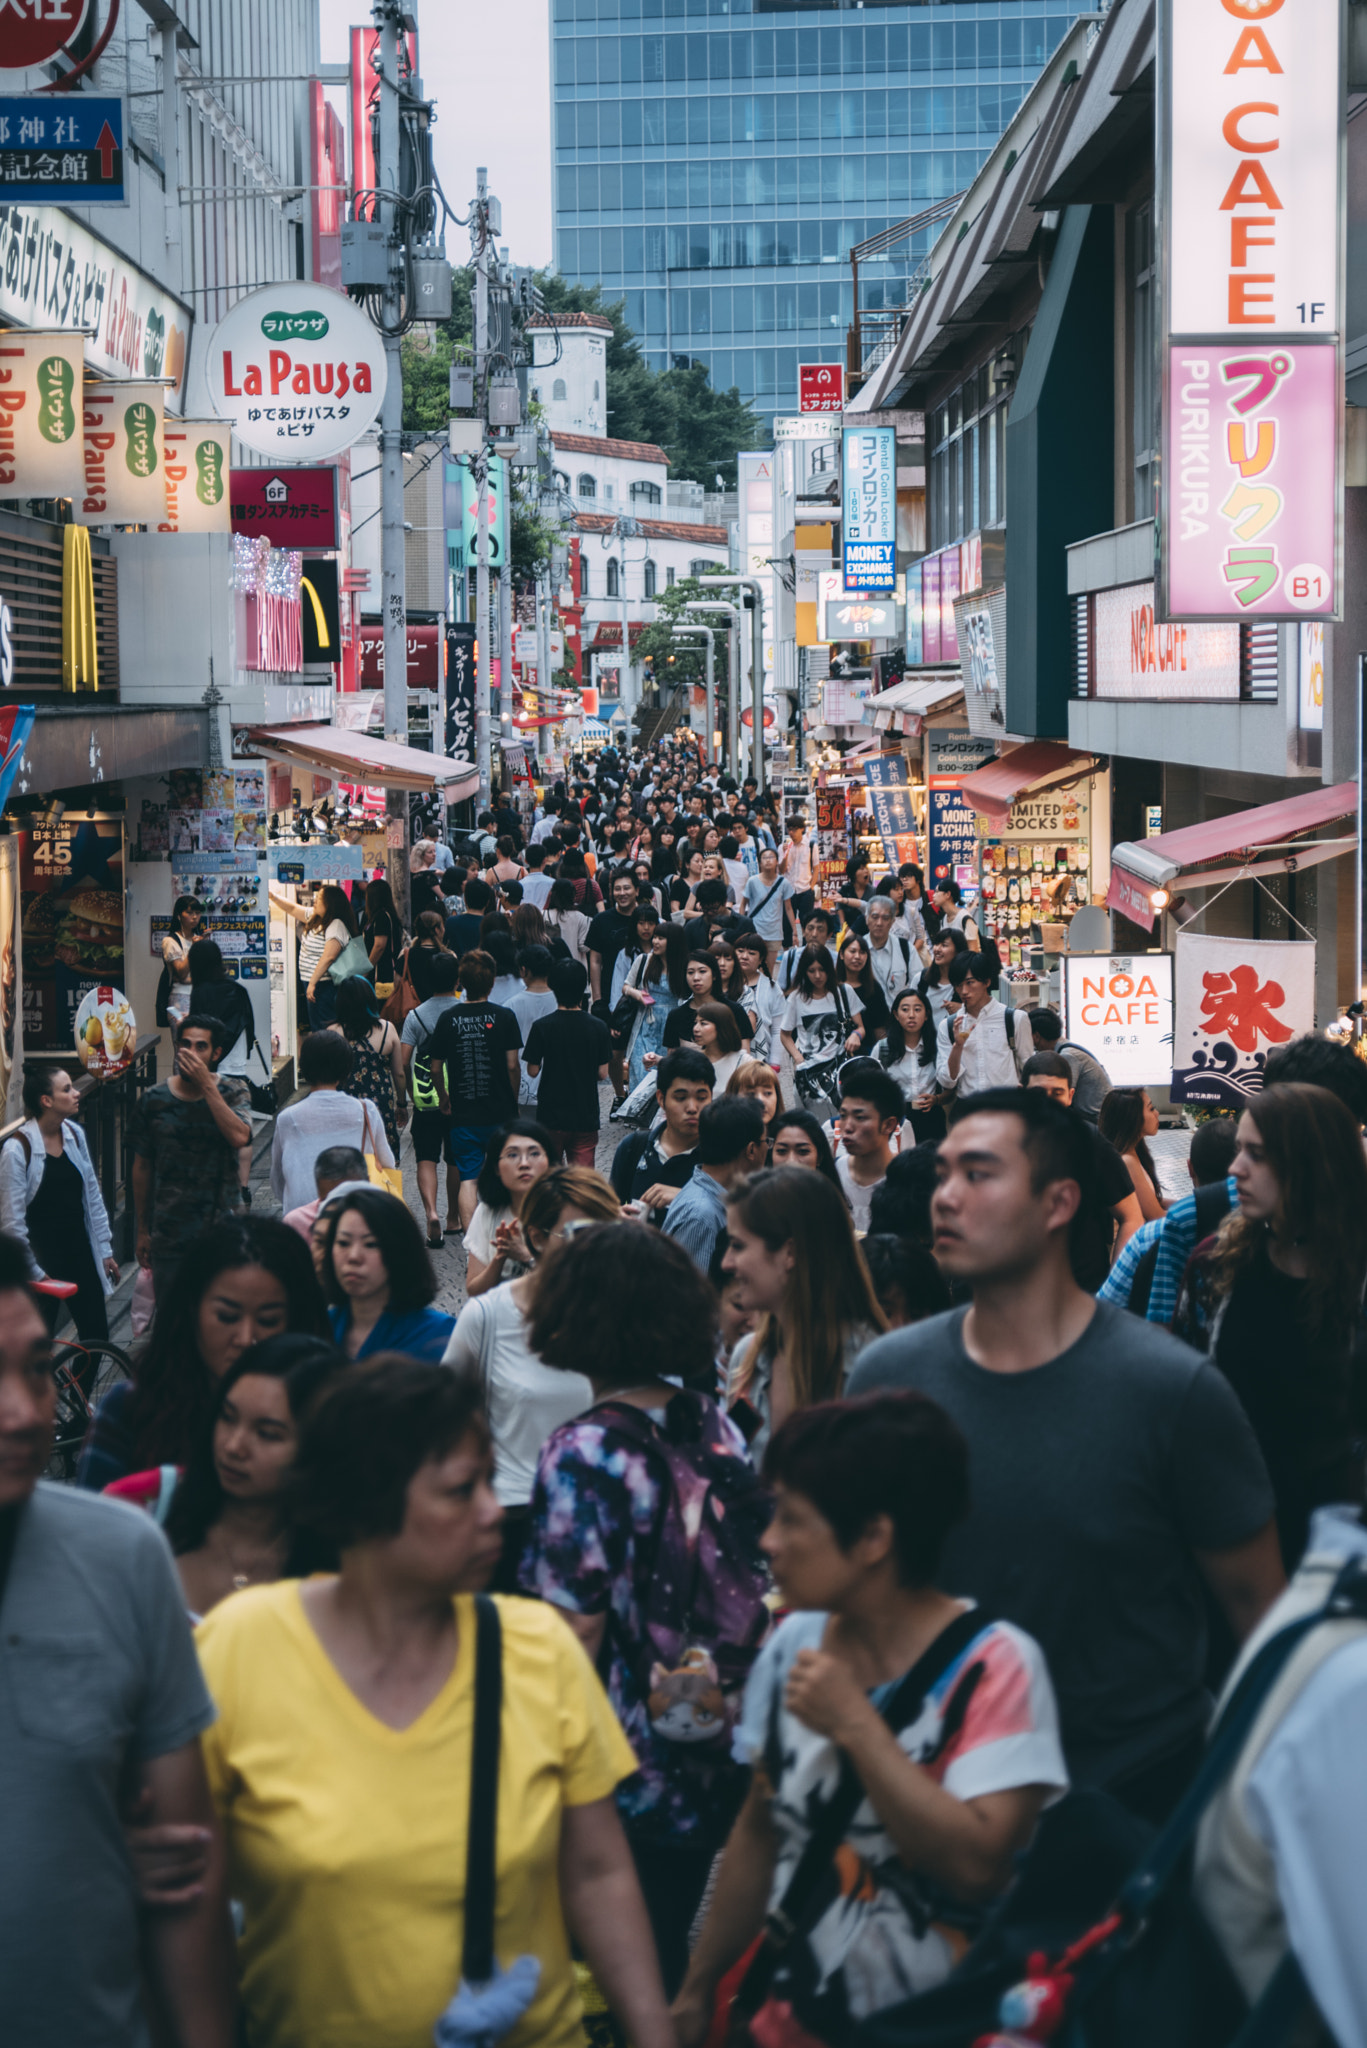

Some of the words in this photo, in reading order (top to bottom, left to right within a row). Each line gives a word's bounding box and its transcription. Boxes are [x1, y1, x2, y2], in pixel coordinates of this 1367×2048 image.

[0, 153, 89, 181] 記念館
[1218, 101, 1285, 325] CAFE
[1296, 303, 1326, 323] 1F
[263, 318, 326, 333] ラパウザ
[223, 350, 263, 396] La
[269, 350, 372, 400] Pausa
[48, 359, 65, 441] ラパウザ
[248, 405, 350, 421] ゆであげパスタ
[133, 405, 150, 476] ラパウザ
[277, 422, 315, 436] &ピザ
[880, 435, 890, 470] Rental
[1180, 360, 1210, 541] PURIKURA
[203, 442, 217, 505] ラパウザ
[1221, 350, 1295, 612] プリクラ
[268, 486, 285, 499] 6F
[862, 436, 878, 538] コインロッカー
[880, 473, 890, 498] Coin
[231, 504, 330, 521] 宿ダンスアカデミー
[880, 500, 890, 539] Locker
[847, 546, 893, 562] MONEY
[846, 562, 894, 575] EXCHANGE
[1293, 577, 1323, 598] B1
[931, 743, 993, 753] コインロッカー
[937, 754, 957, 762] Coin
[818, 804, 845, 827] 50
[1006, 817, 1058, 830] SOCKS
[33, 830, 71, 841] 日本上陸
[33, 841, 72, 865] 45
[209, 921, 265, 930] 七夕フェスティバル
[1083, 974, 1159, 999] NOA
[1081, 1002, 1160, 1026] CAFE
[1199, 963, 1296, 1053] 氷
[1103, 1036, 1140, 1045] 原宿店
